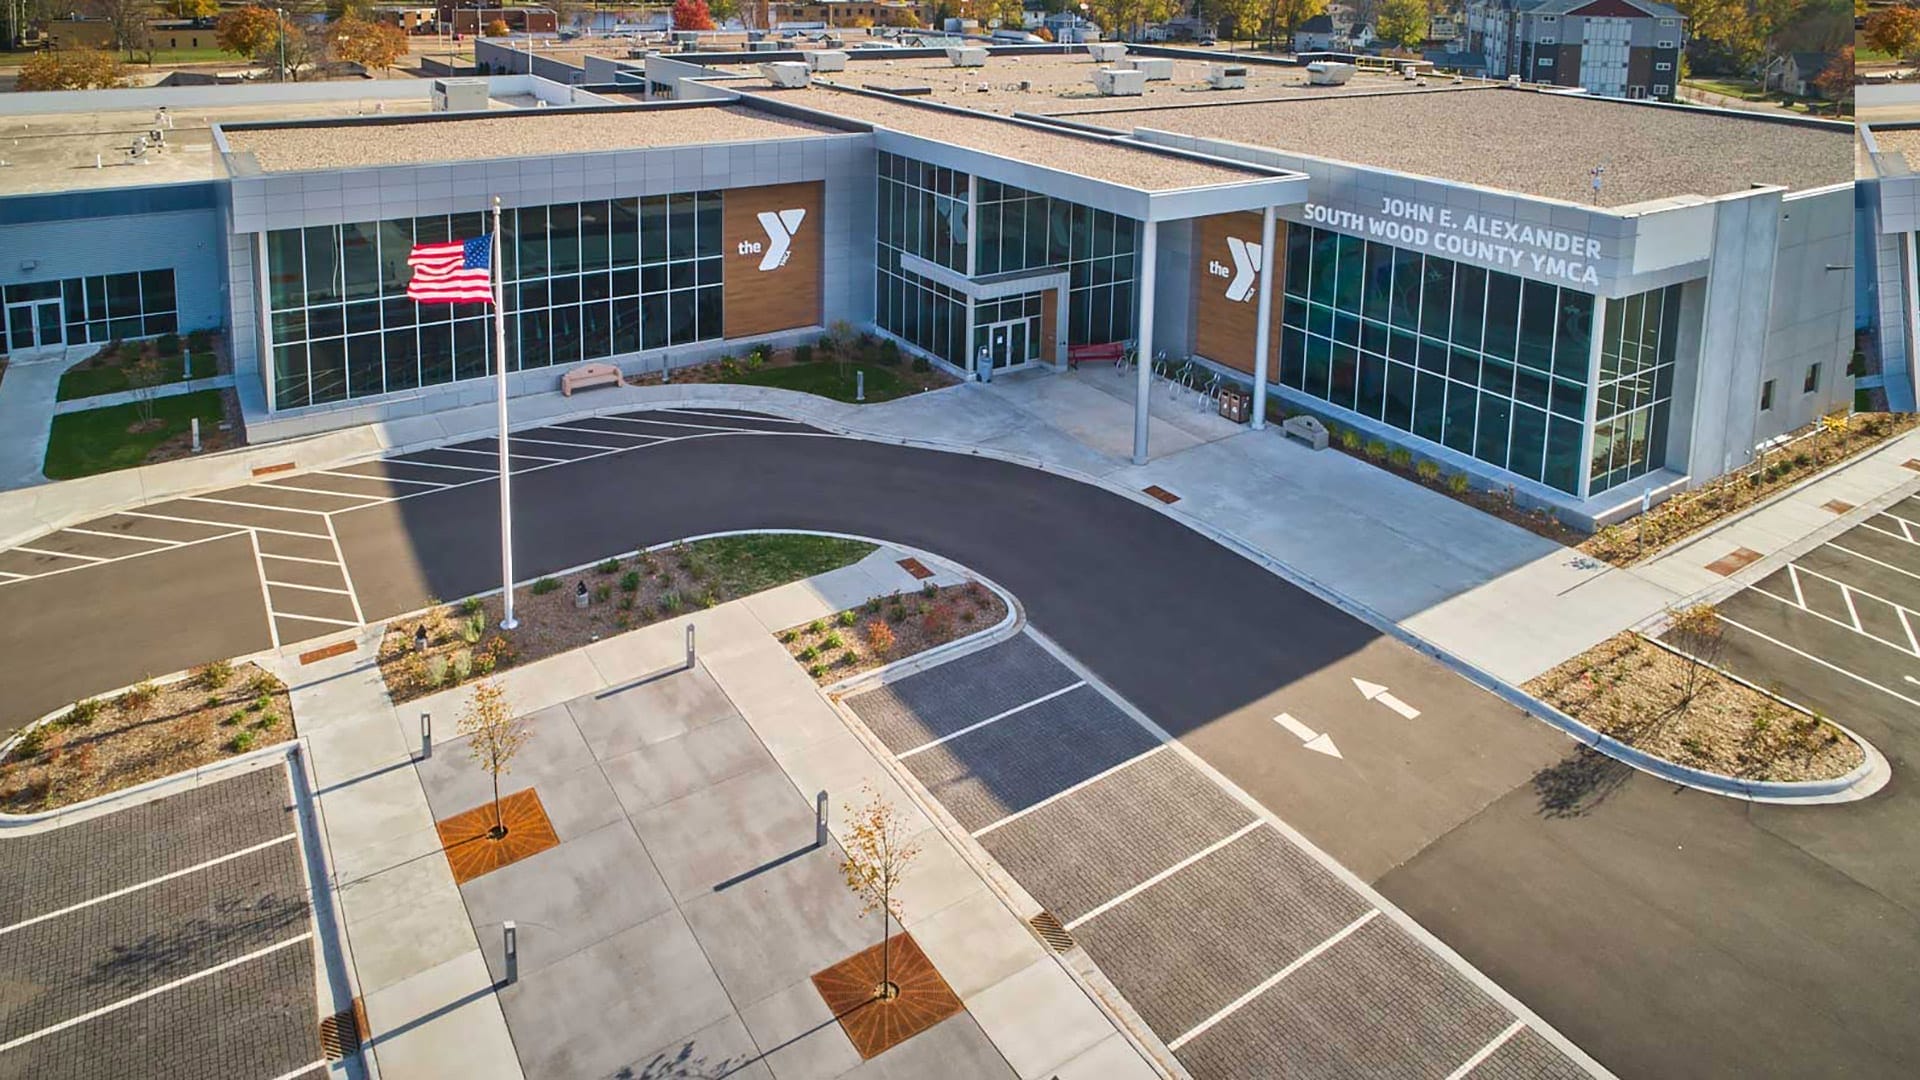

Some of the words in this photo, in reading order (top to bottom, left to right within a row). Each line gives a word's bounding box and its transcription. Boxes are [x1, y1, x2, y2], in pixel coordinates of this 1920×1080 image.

[738, 241, 761, 255] the
[1304, 203, 1364, 231] SOUTH
[1368, 217, 1428, 246] WOOD
[1434, 232, 1524, 268] COUNTY
[1531, 253, 1599, 286] YMCA
[1381, 197, 1434, 224] JOHN
[1440, 209, 1458, 229] E.
[1463, 214, 1602, 260] ALEXANDER
[1209, 260, 1229, 278] the
